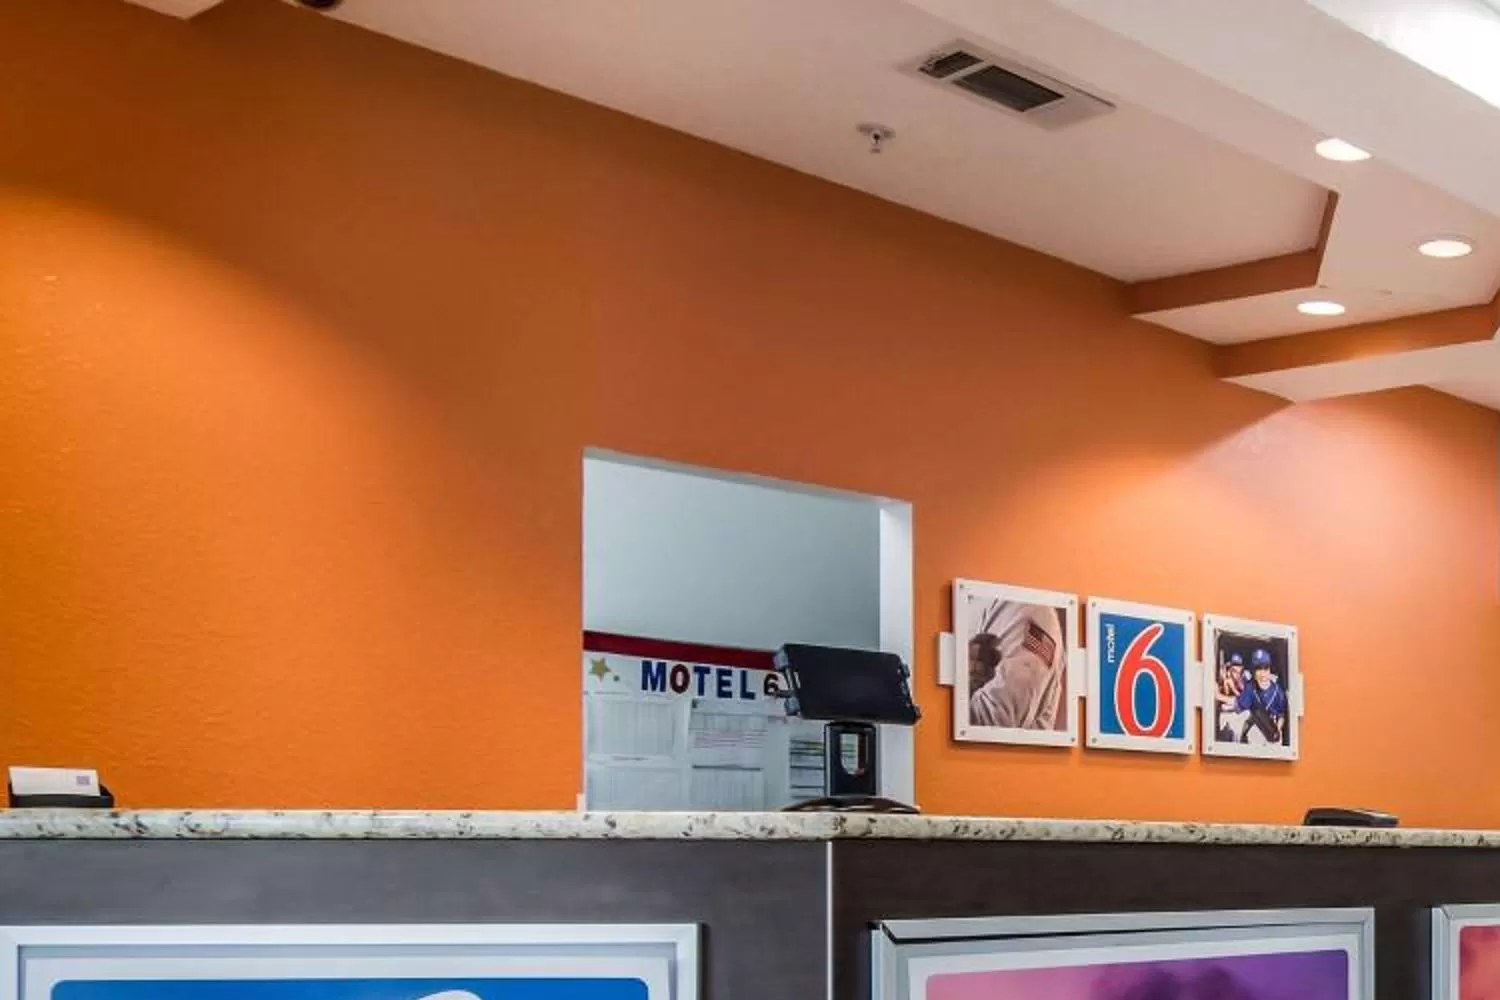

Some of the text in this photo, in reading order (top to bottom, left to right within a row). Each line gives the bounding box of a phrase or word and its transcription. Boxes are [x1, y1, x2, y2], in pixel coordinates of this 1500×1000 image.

[641, 660, 779, 700] MOTEL 6
[1114, 623, 1175, 737] 6
